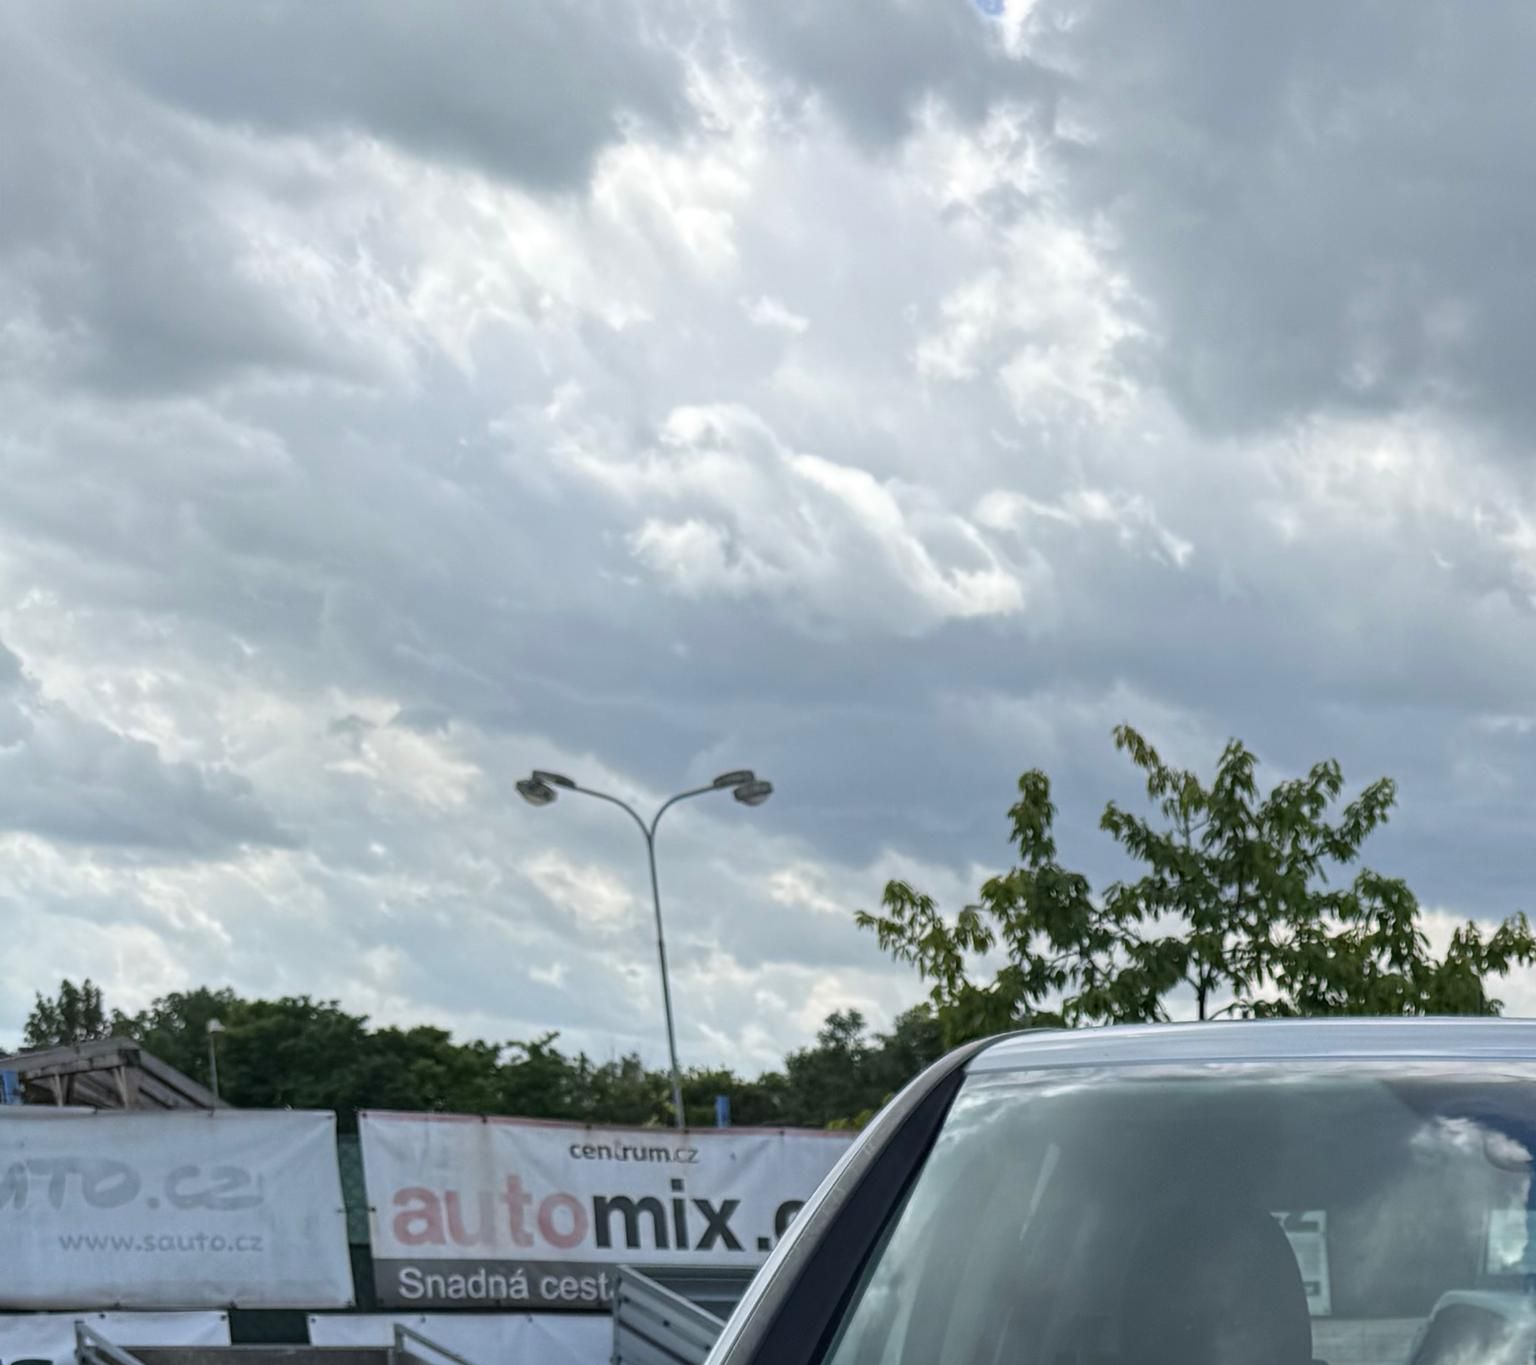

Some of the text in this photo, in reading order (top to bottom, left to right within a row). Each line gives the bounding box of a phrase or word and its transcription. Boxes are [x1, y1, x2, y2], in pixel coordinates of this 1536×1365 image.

[568, 1138, 701, 1165] centrum.cz
[58, 1231, 265, 1253] www.sauto.cz
[398, 1265, 614, 1302] Snadná cest
